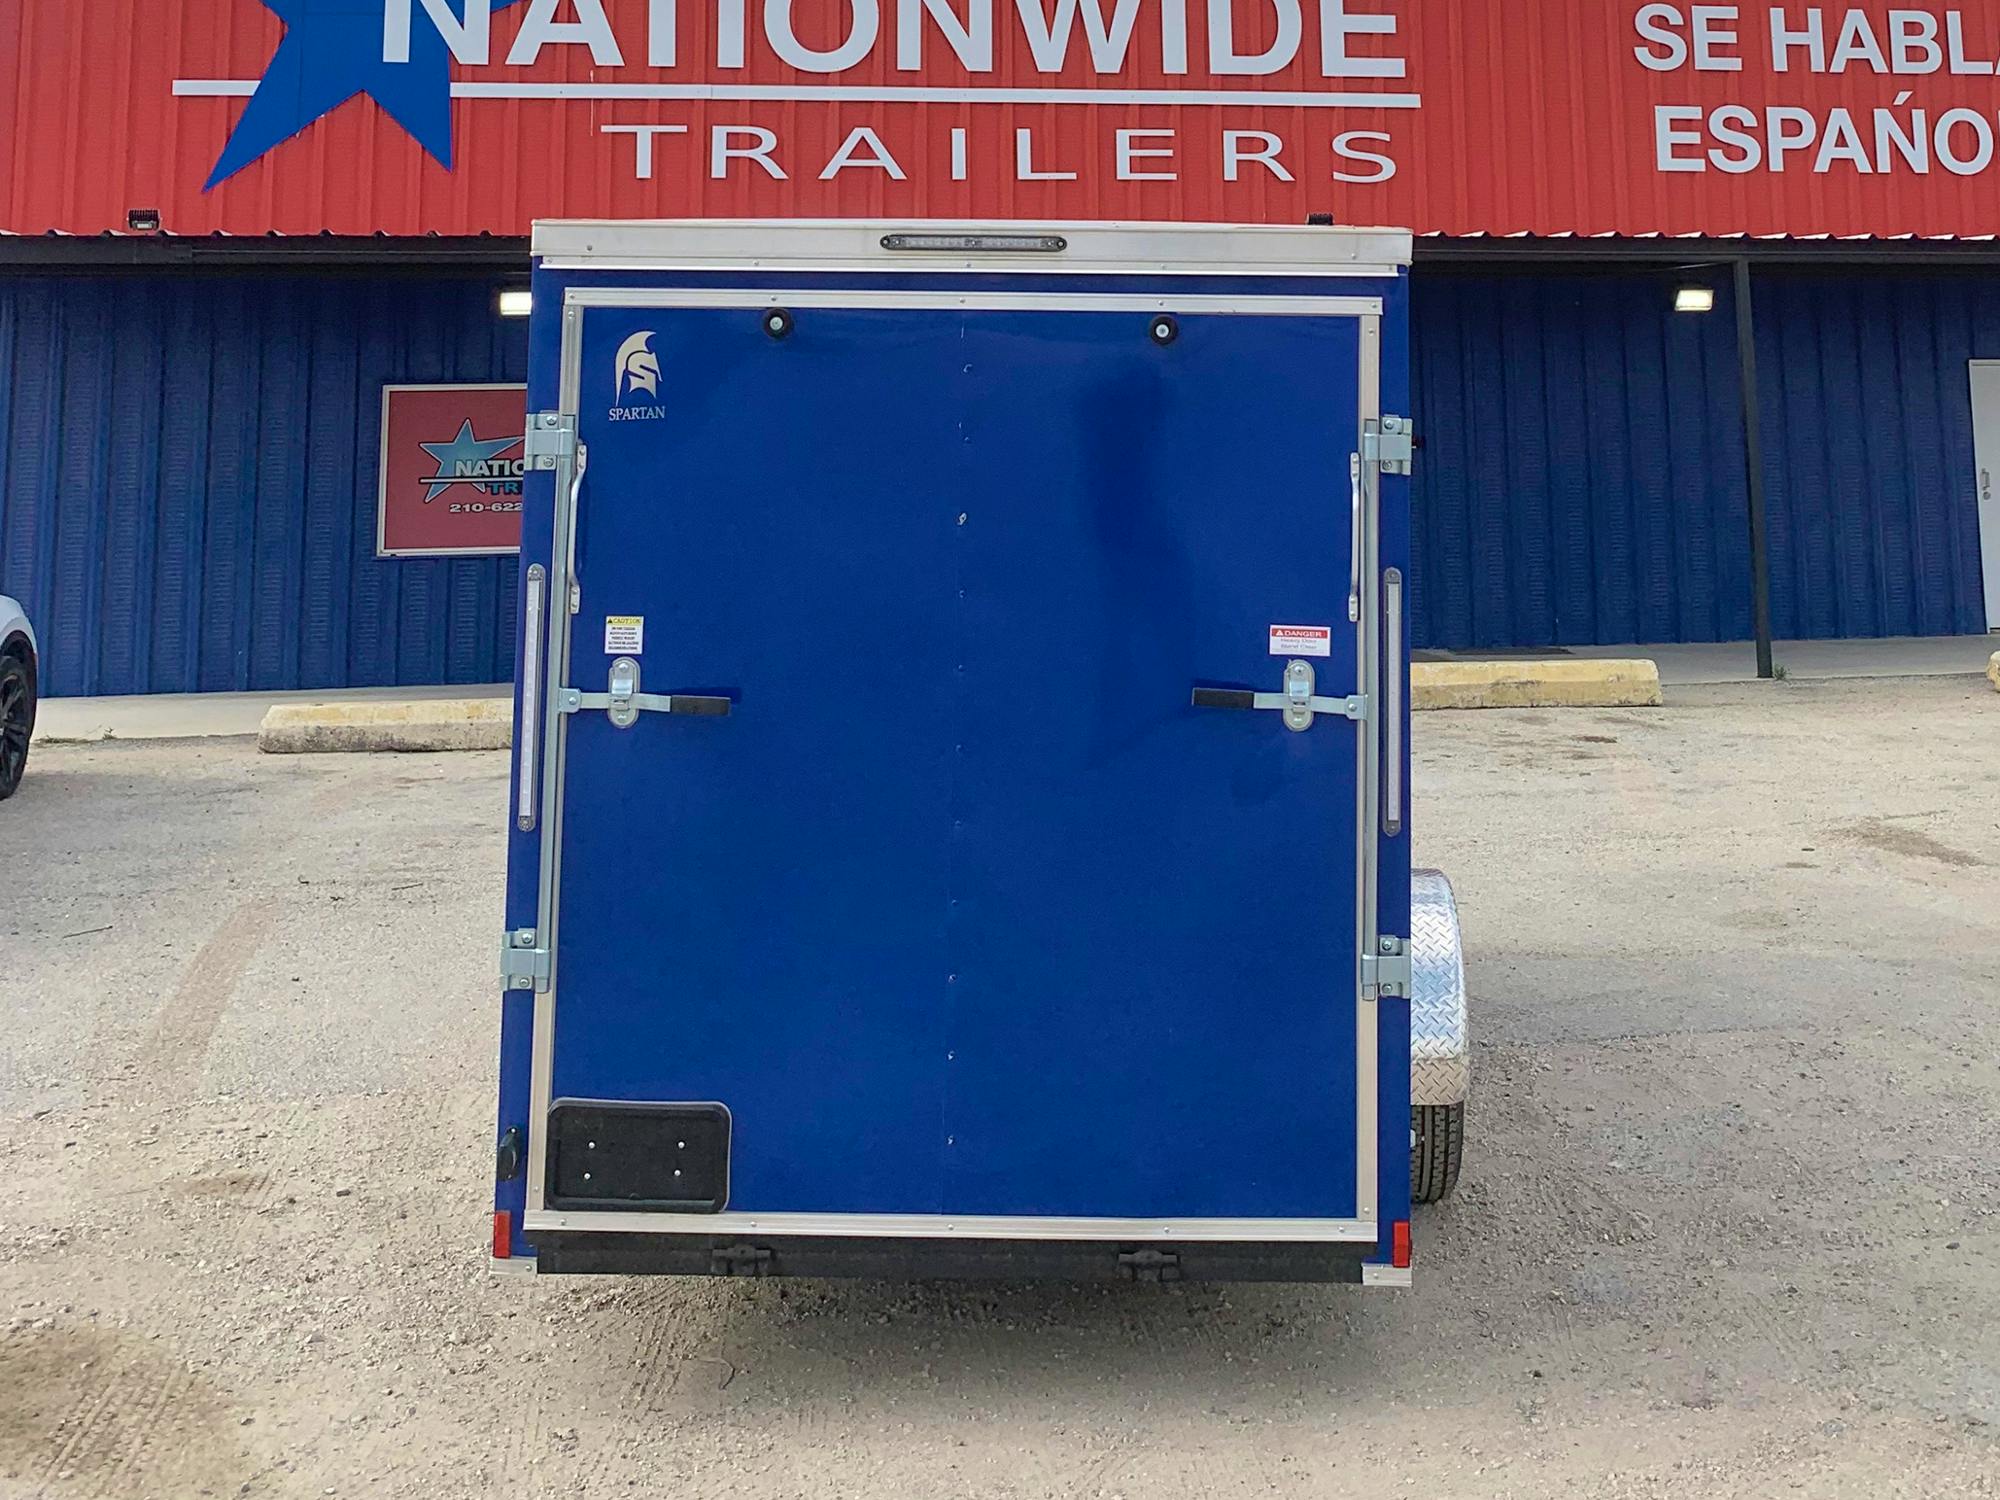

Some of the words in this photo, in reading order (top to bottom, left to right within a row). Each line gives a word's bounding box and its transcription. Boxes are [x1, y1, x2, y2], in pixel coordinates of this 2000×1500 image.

[1633, 3, 1742, 72] SE
[1769, 7, 2000, 76] HABL
[600, 124, 1397, 183] TRAILERS
[608, 407, 665, 420] SPARTAN
